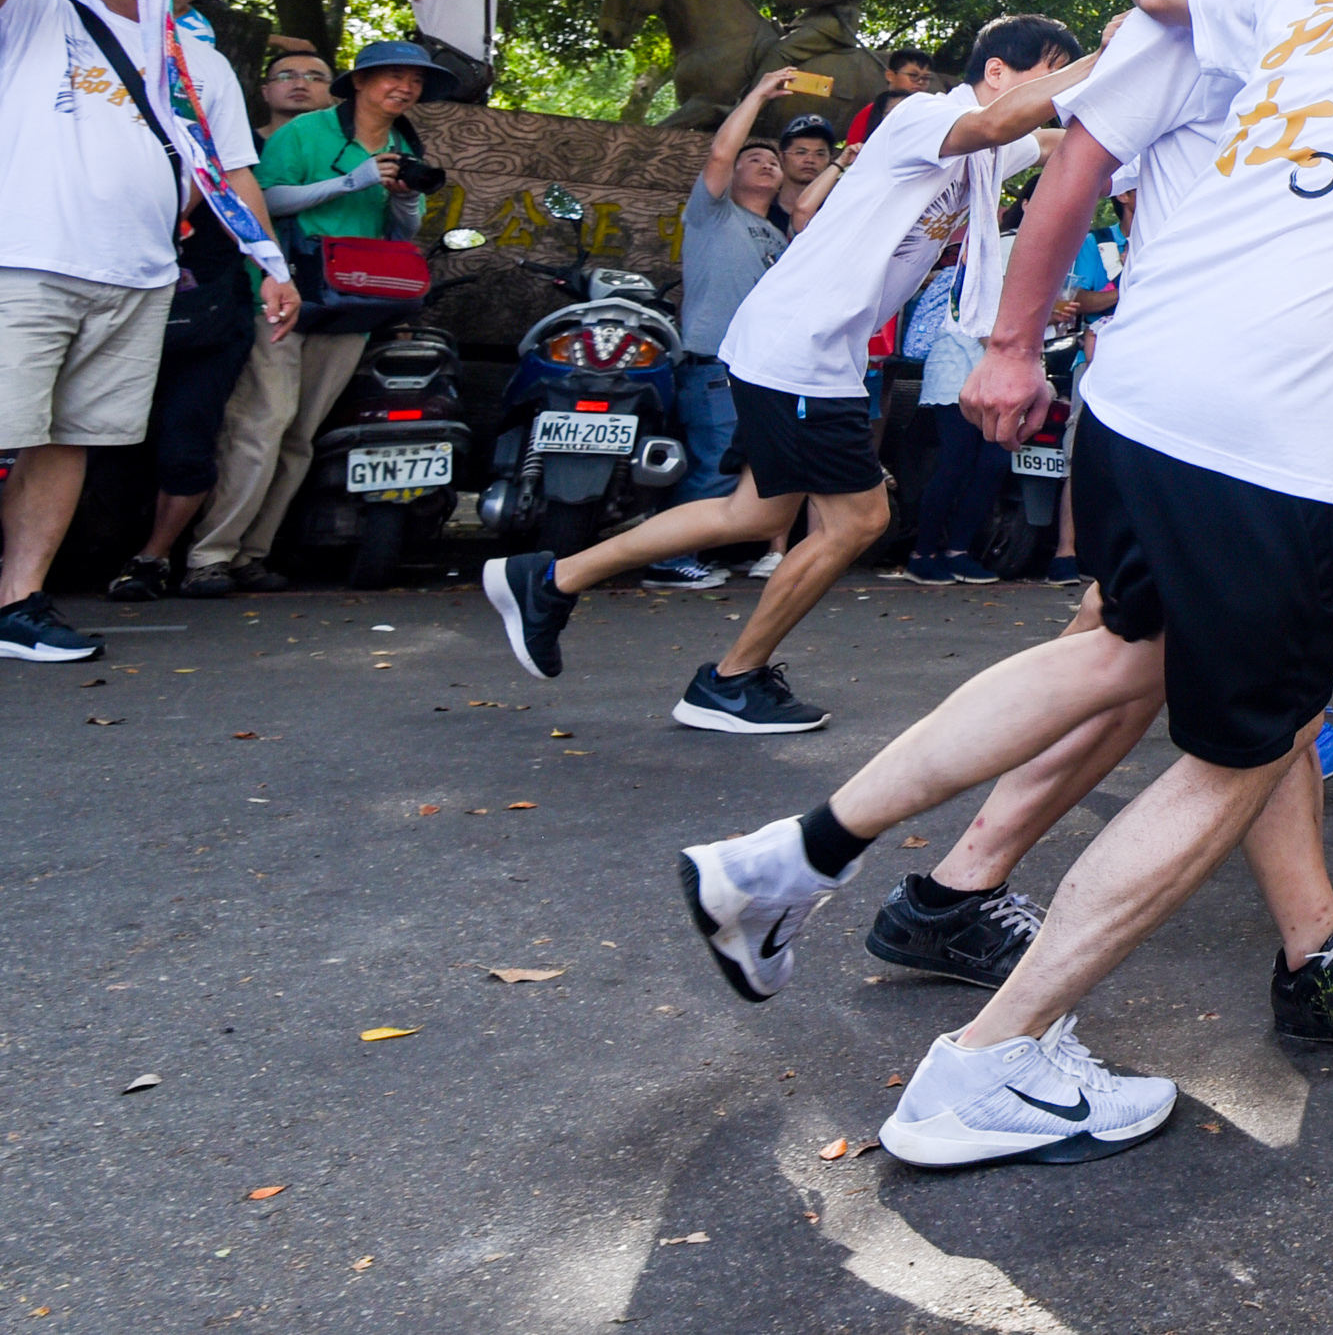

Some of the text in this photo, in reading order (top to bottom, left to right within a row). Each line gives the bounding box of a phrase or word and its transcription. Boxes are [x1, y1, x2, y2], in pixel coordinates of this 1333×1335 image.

[540, 422, 632, 444] MKH-2035
[351, 457, 448, 484] GYN-773
[1016, 454, 1064, 473] 169-DB
